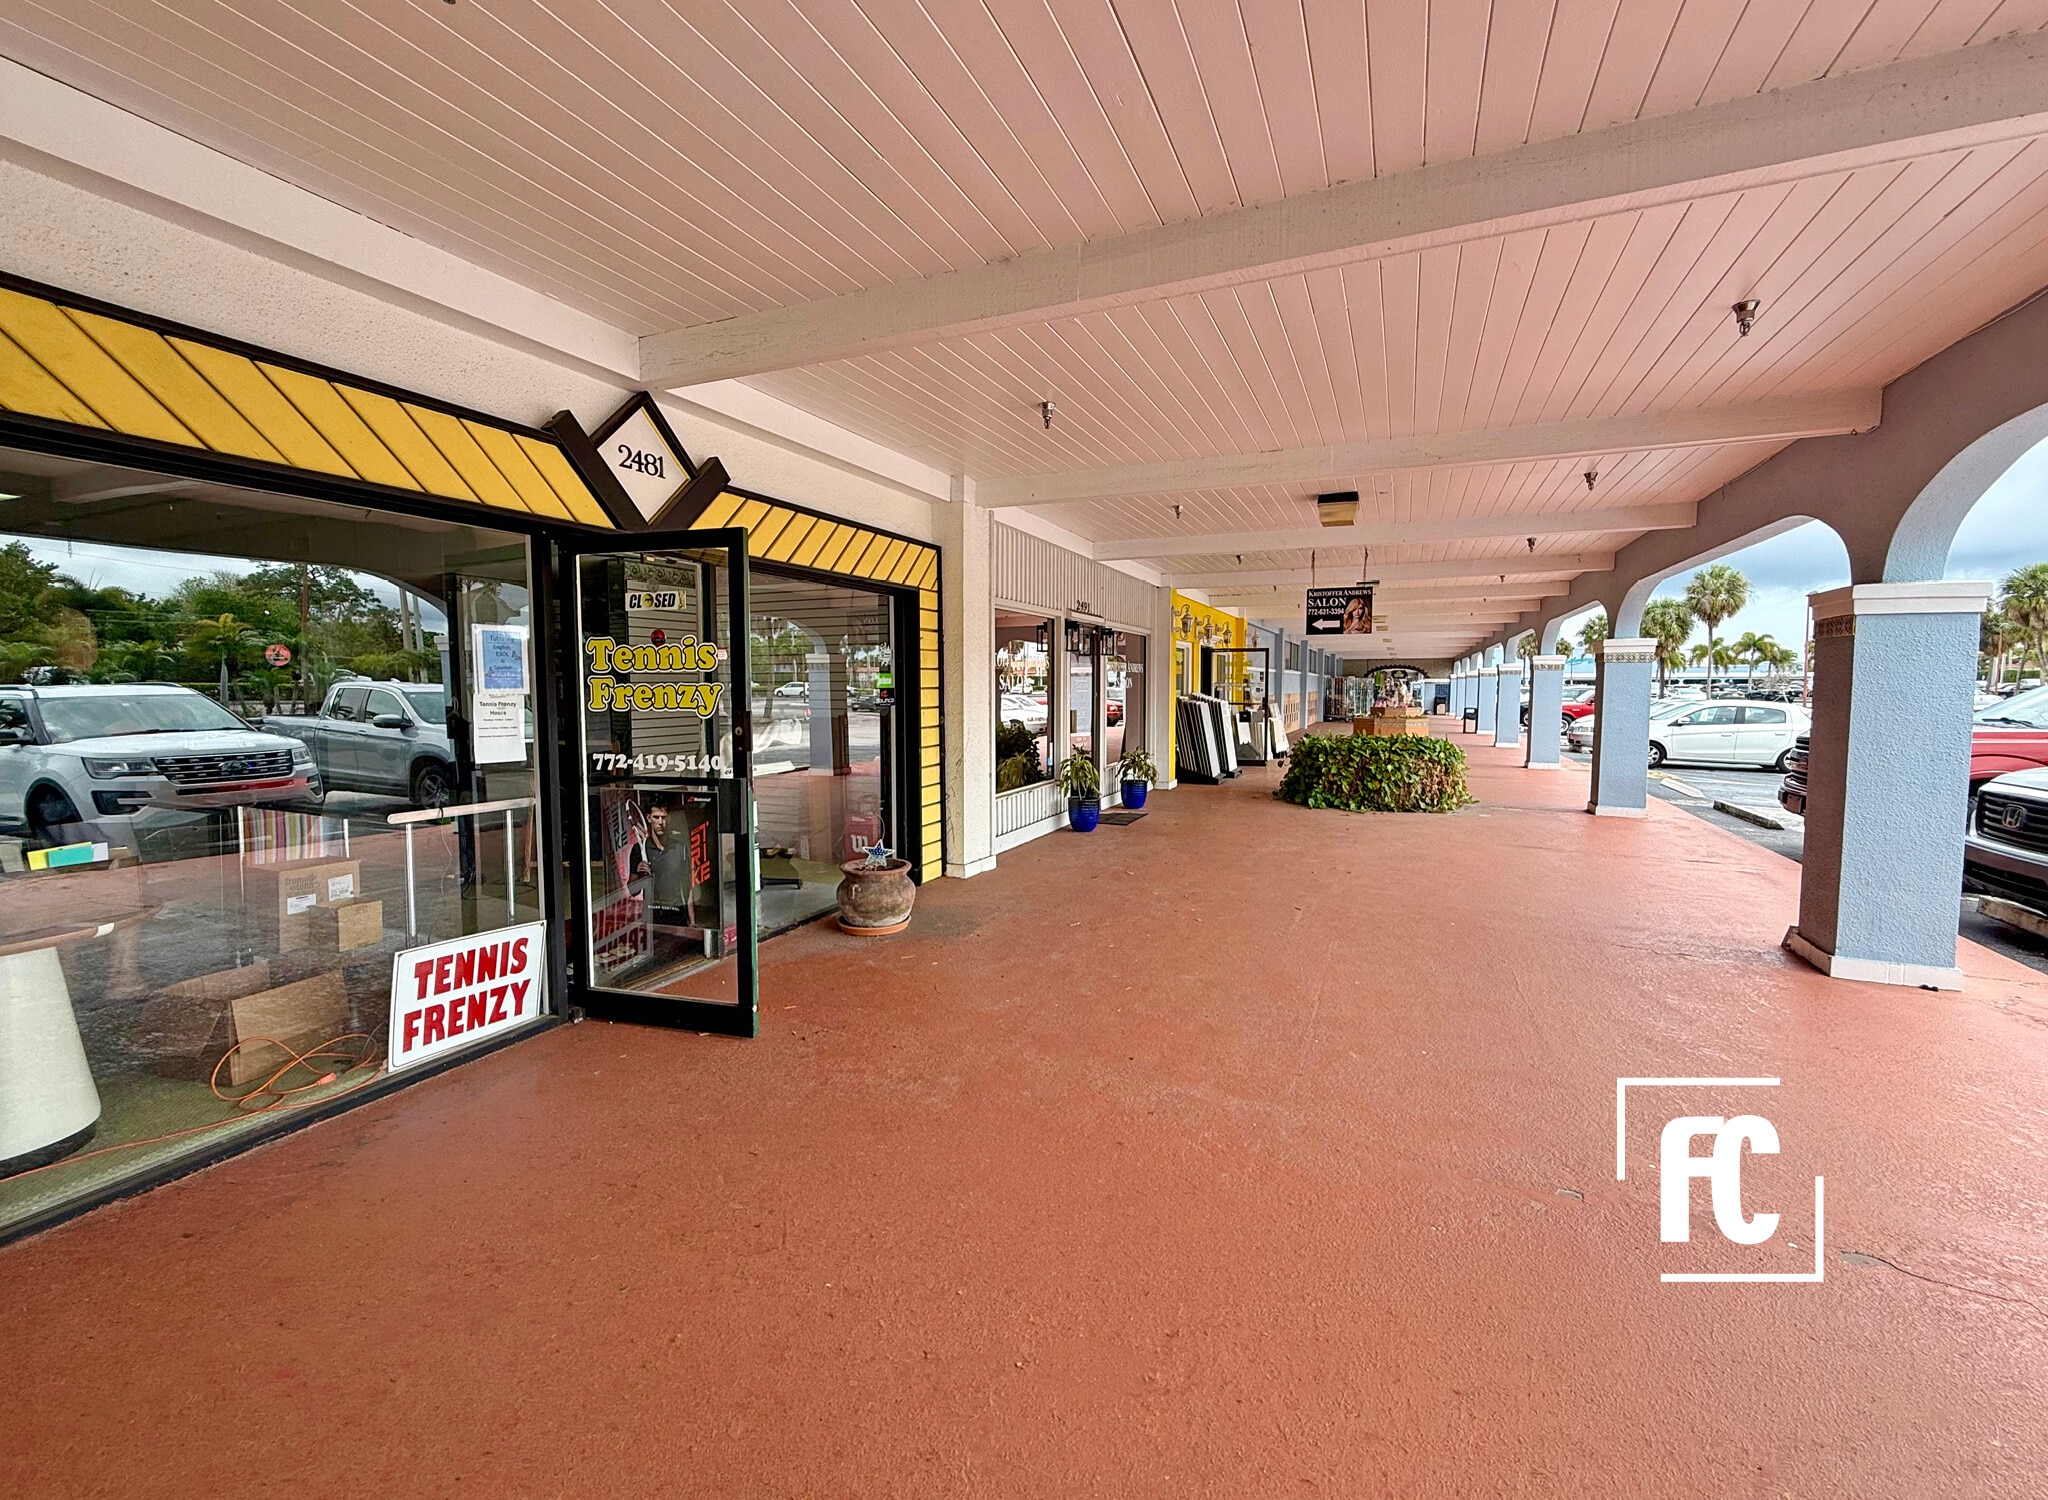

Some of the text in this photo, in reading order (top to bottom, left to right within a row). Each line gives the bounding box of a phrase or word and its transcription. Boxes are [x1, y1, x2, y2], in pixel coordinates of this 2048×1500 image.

[617, 444, 667, 480] 2481
[1076, 599, 1090, 613] 2491
[1307, 597, 1347, 607] SALON
[586, 634, 719, 674] Tennis
[587, 675, 725, 719] Frenzy
[592, 753, 726, 772] 772-419-5140
[414, 937, 529, 1001] TENNIS
[402, 978, 532, 1053] FRENZY
